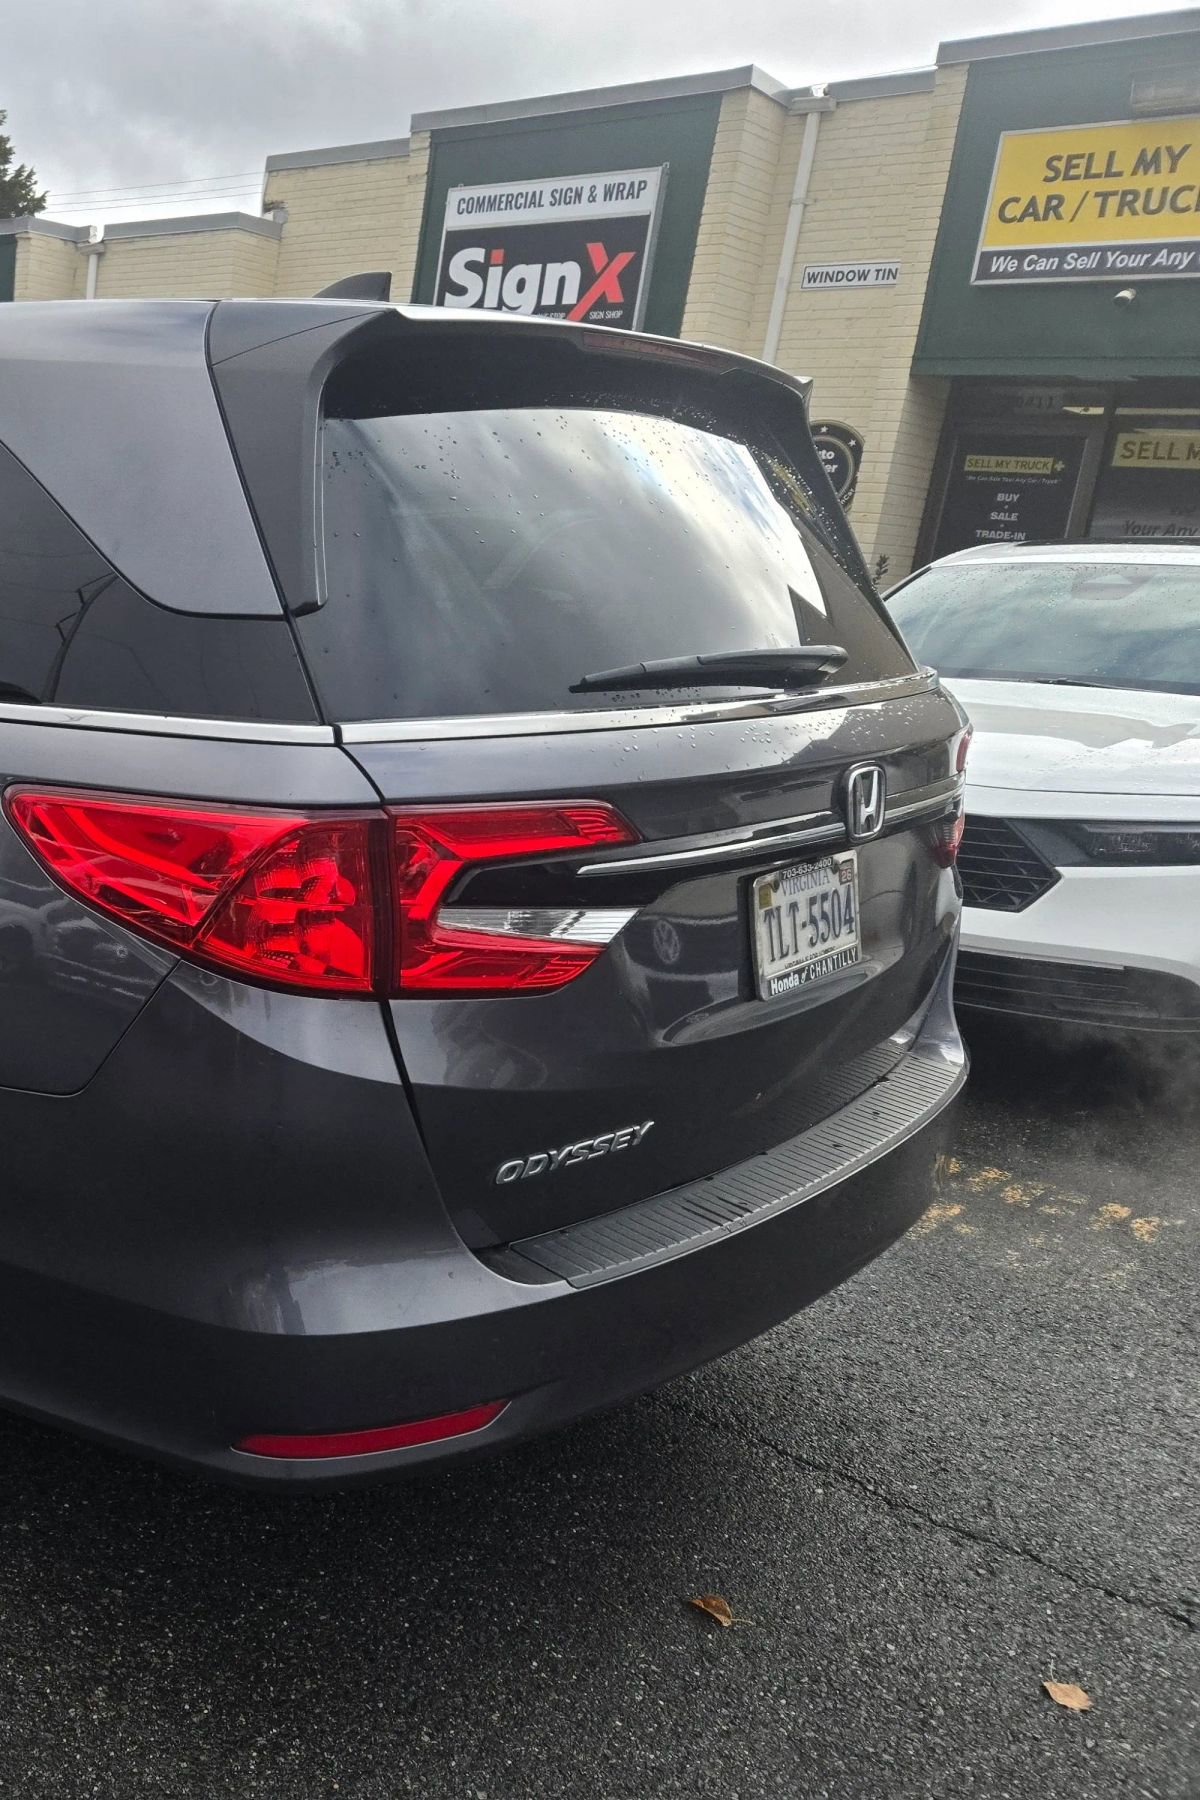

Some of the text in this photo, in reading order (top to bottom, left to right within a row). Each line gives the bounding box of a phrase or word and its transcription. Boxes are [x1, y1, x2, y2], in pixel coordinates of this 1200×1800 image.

[1042, 143, 1193, 183] SELL MY
[456, 179, 648, 215] COMMERCIAL SIGN & WRAP
[997, 193, 1066, 224] CAR
[990, 248, 1196, 273] We Can Sell Your Any
[443, 241, 637, 321] SignX
[806, 269, 871, 284] WINDOW
[588, 311, 605, 320] SIGN
[605, 310, 624, 319] SHOP
[1119, 440, 1180, 461] SELL
[967, 458, 1050, 471] SELL MY TRUCK
[996, 493, 1020, 502] BUY
[990, 511, 1019, 521] SALE
[1123, 520, 1160, 536] Your
[975, 529, 1026, 540] TRADE-IN
[780, 868, 830, 897] VIRGINIA
[763, 884, 855, 963] TLT-5504
[770, 971, 800, 996] Honda
[809, 947, 857, 980] CHANTILLY
[495, 1120, 655, 1185] ODYSSEY
